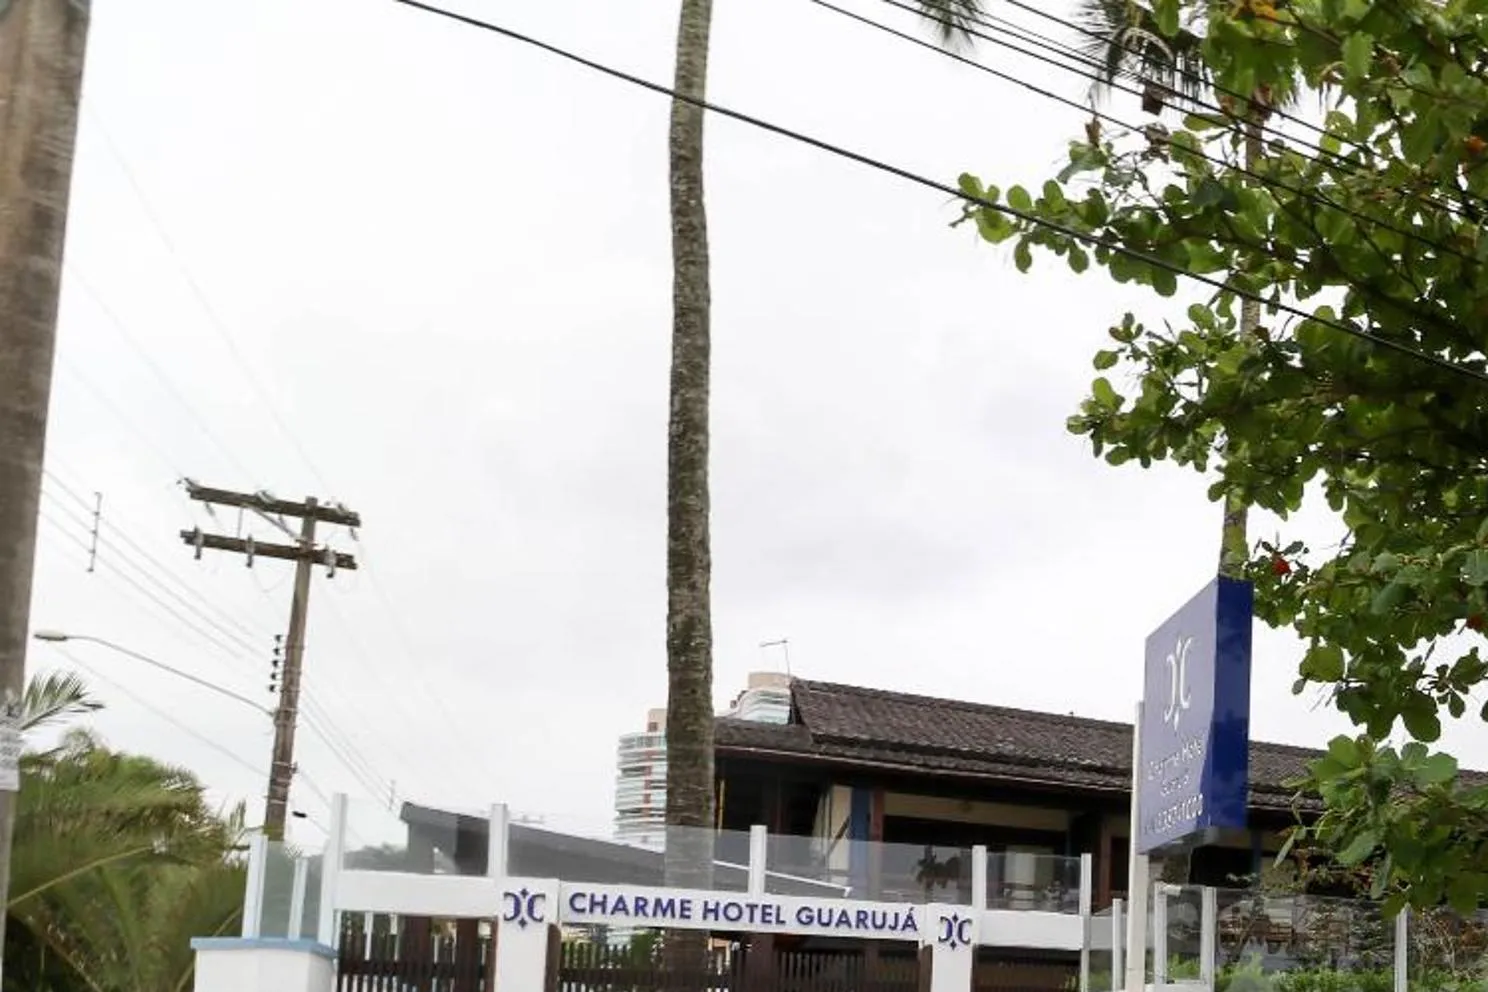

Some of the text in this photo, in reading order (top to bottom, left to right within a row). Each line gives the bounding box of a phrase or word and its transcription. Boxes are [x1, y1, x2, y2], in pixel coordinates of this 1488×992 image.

[568, 892, 919, 932] CHARME HOTEL GUARUJÁ
